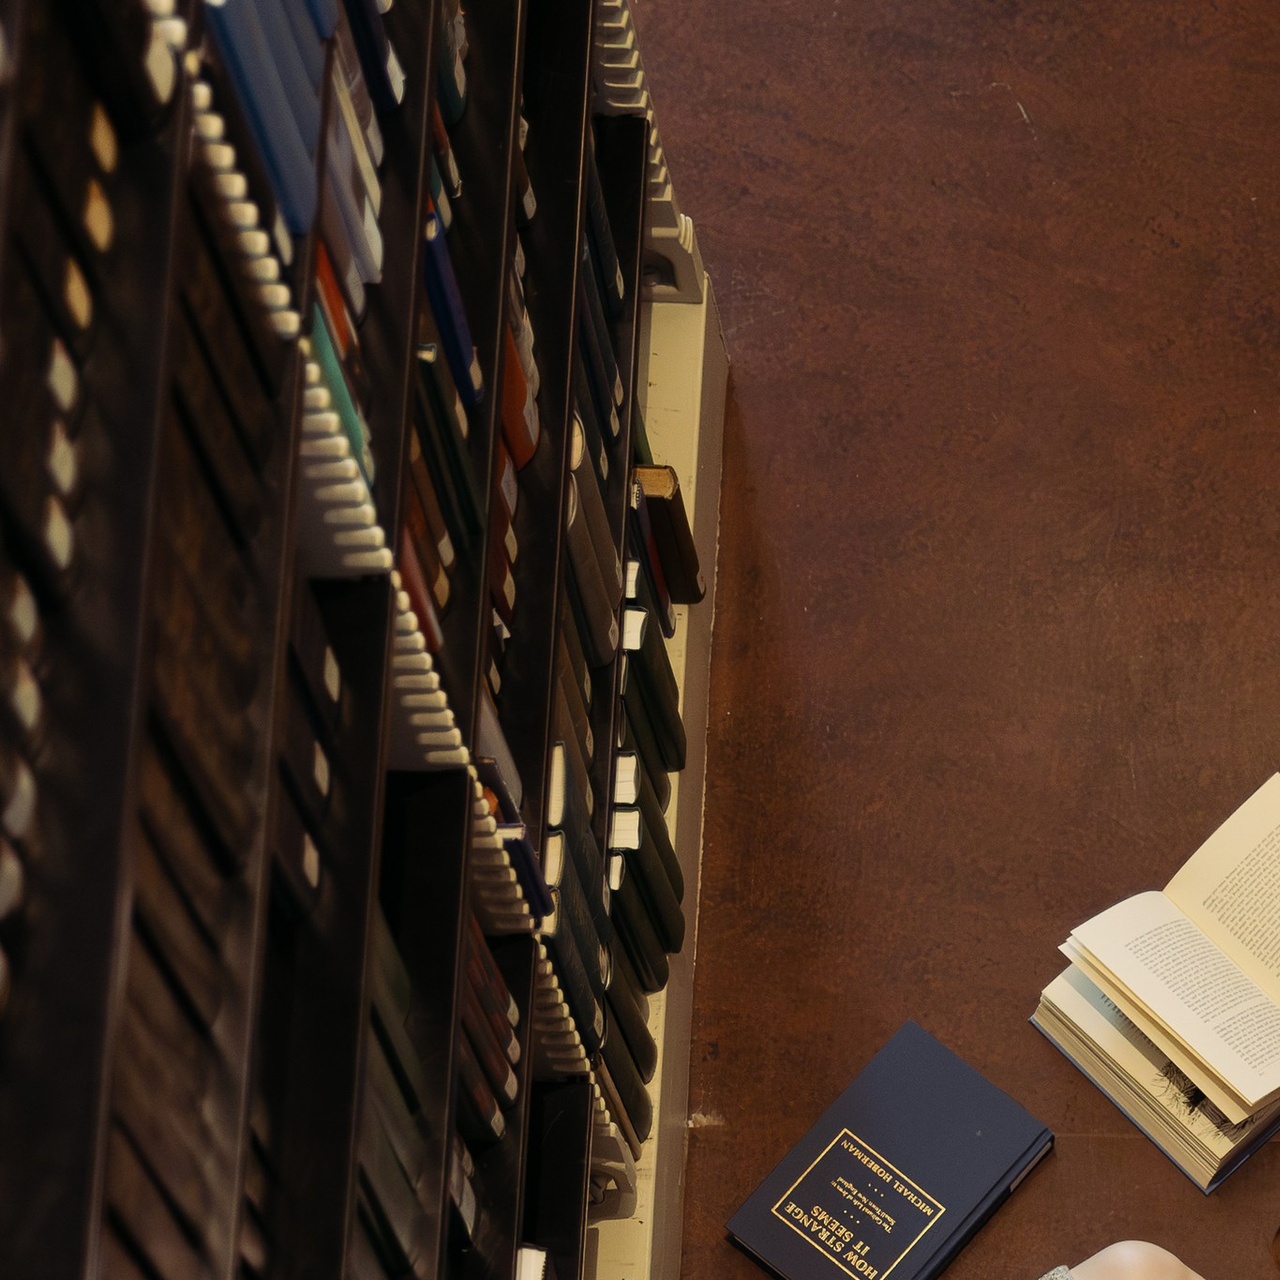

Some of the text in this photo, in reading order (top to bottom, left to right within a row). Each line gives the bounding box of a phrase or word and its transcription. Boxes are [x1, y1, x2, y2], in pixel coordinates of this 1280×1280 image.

[836, 1176, 859, 1196] England
[840, 1139, 934, 1217] MICHAEL HOBERMAN
[856, 1192, 870, 1204] New
[784, 1201, 879, 1280] HOW STRANGE
[810, 1205, 871, 1257] IT SEEMS
[881, 1221, 893, 1234] The
